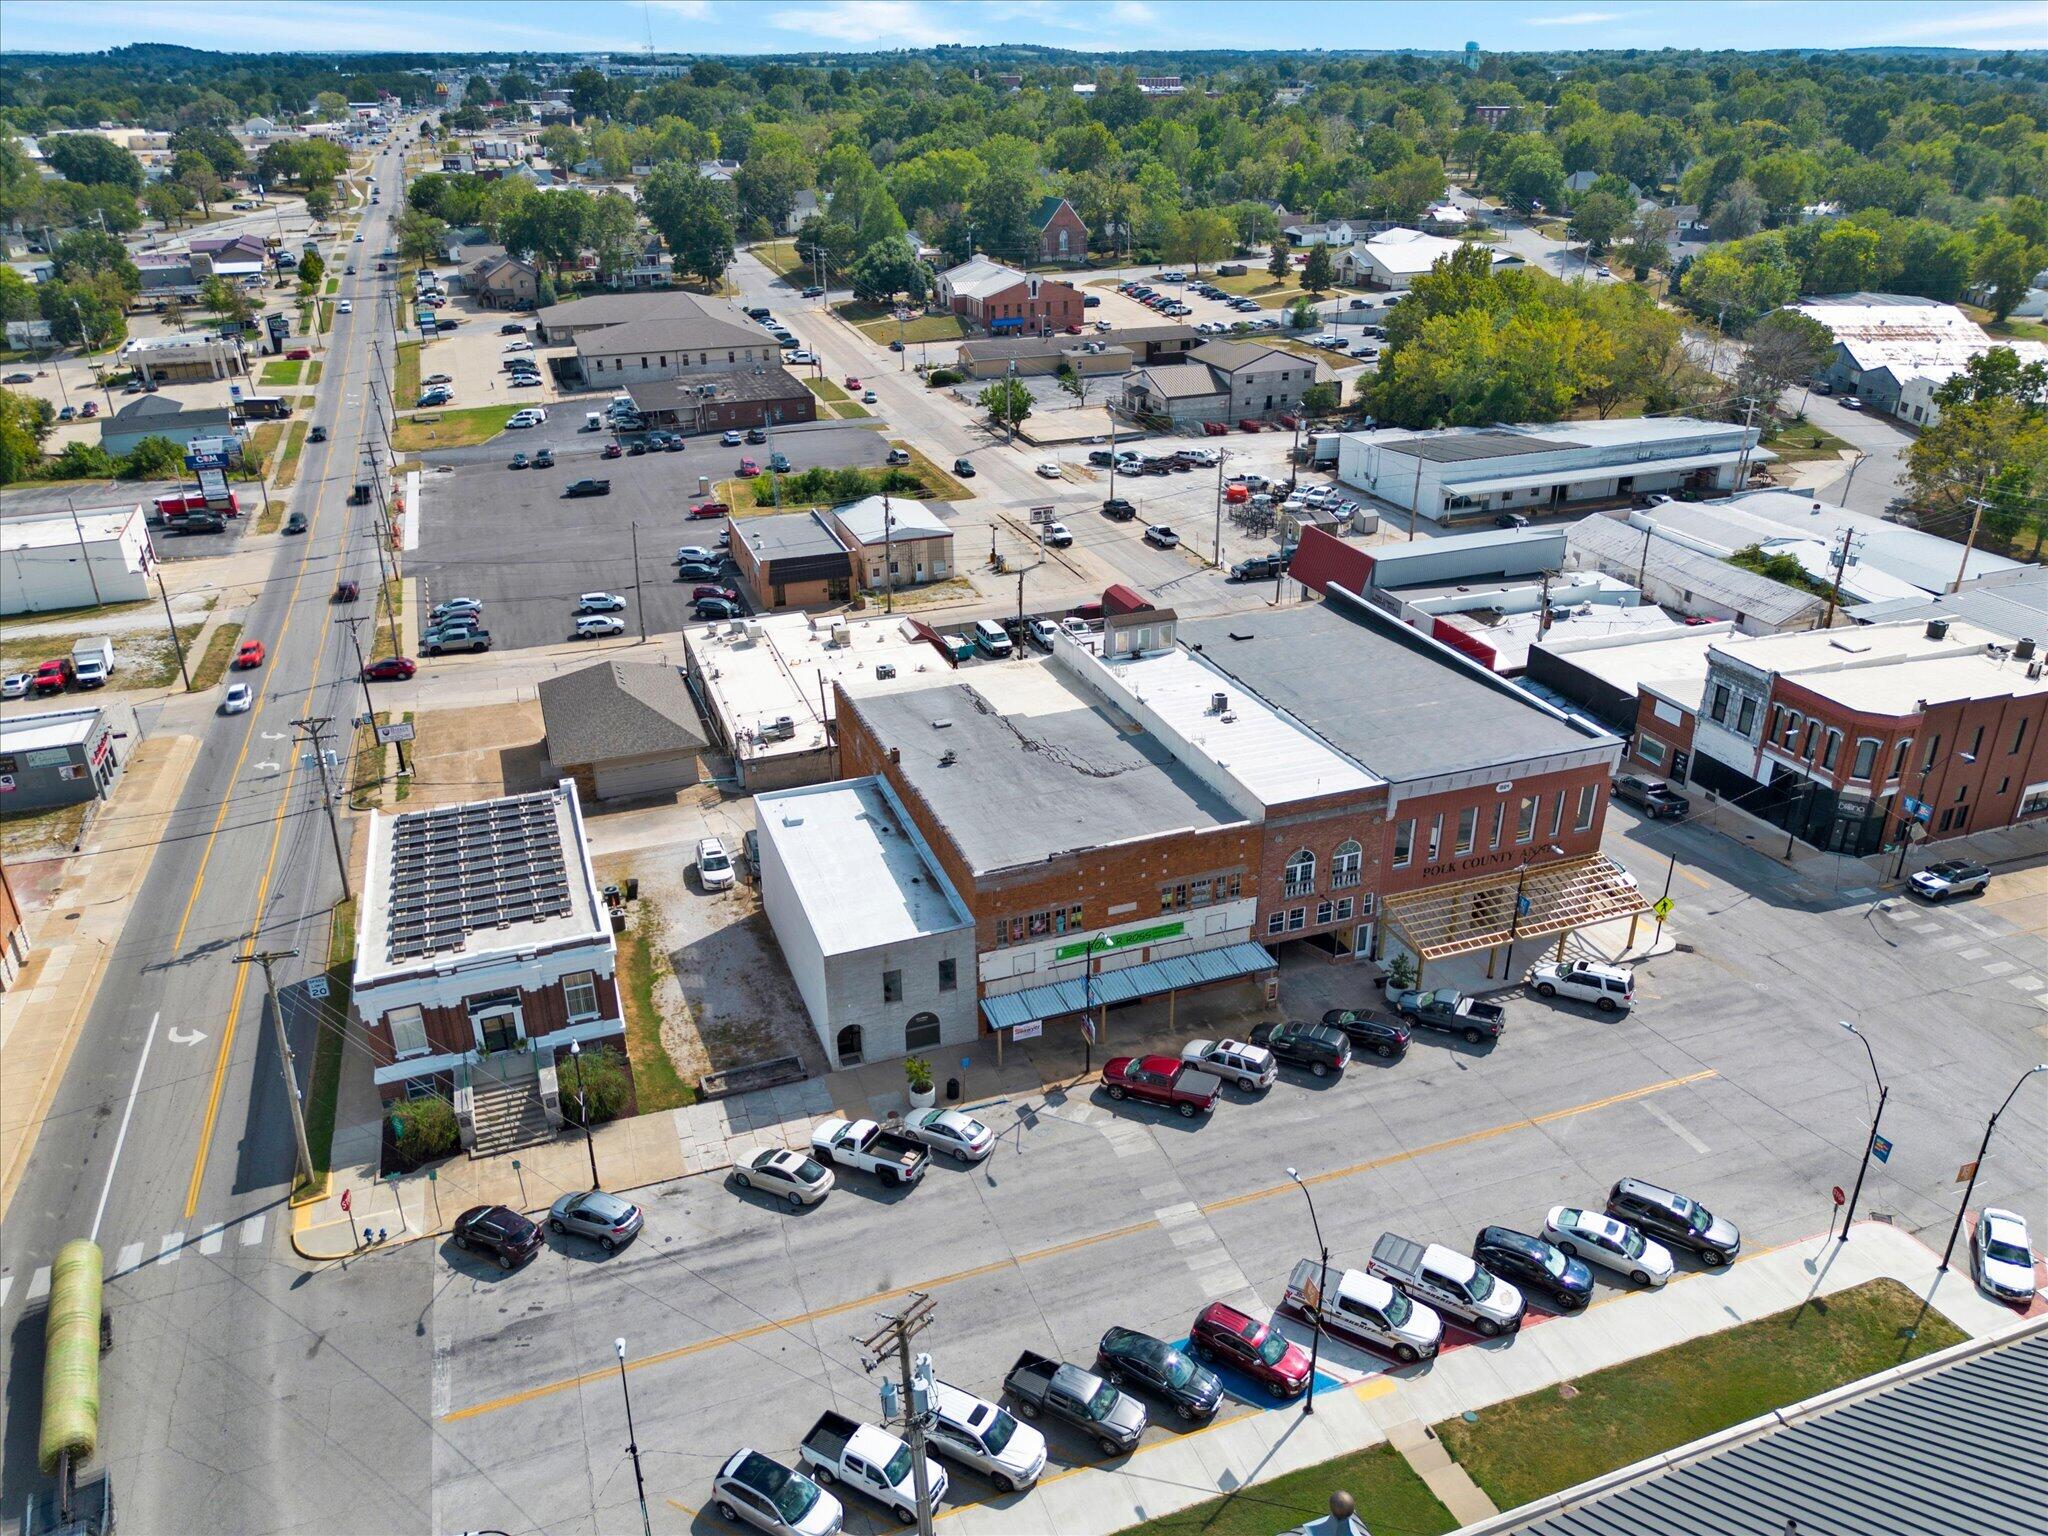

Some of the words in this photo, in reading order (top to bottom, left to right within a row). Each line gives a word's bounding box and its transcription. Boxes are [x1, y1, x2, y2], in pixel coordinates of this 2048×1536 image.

[1423, 862, 1456, 877] POLK
[1462, 850, 1515, 870] COUNTY
[1126, 932, 1152, 943] ROSS
[312, 988, 327, 996] 20
[1425, 1290, 1459, 1306] SHERIFF
[1342, 1317, 1376, 1332] SHERIFF
